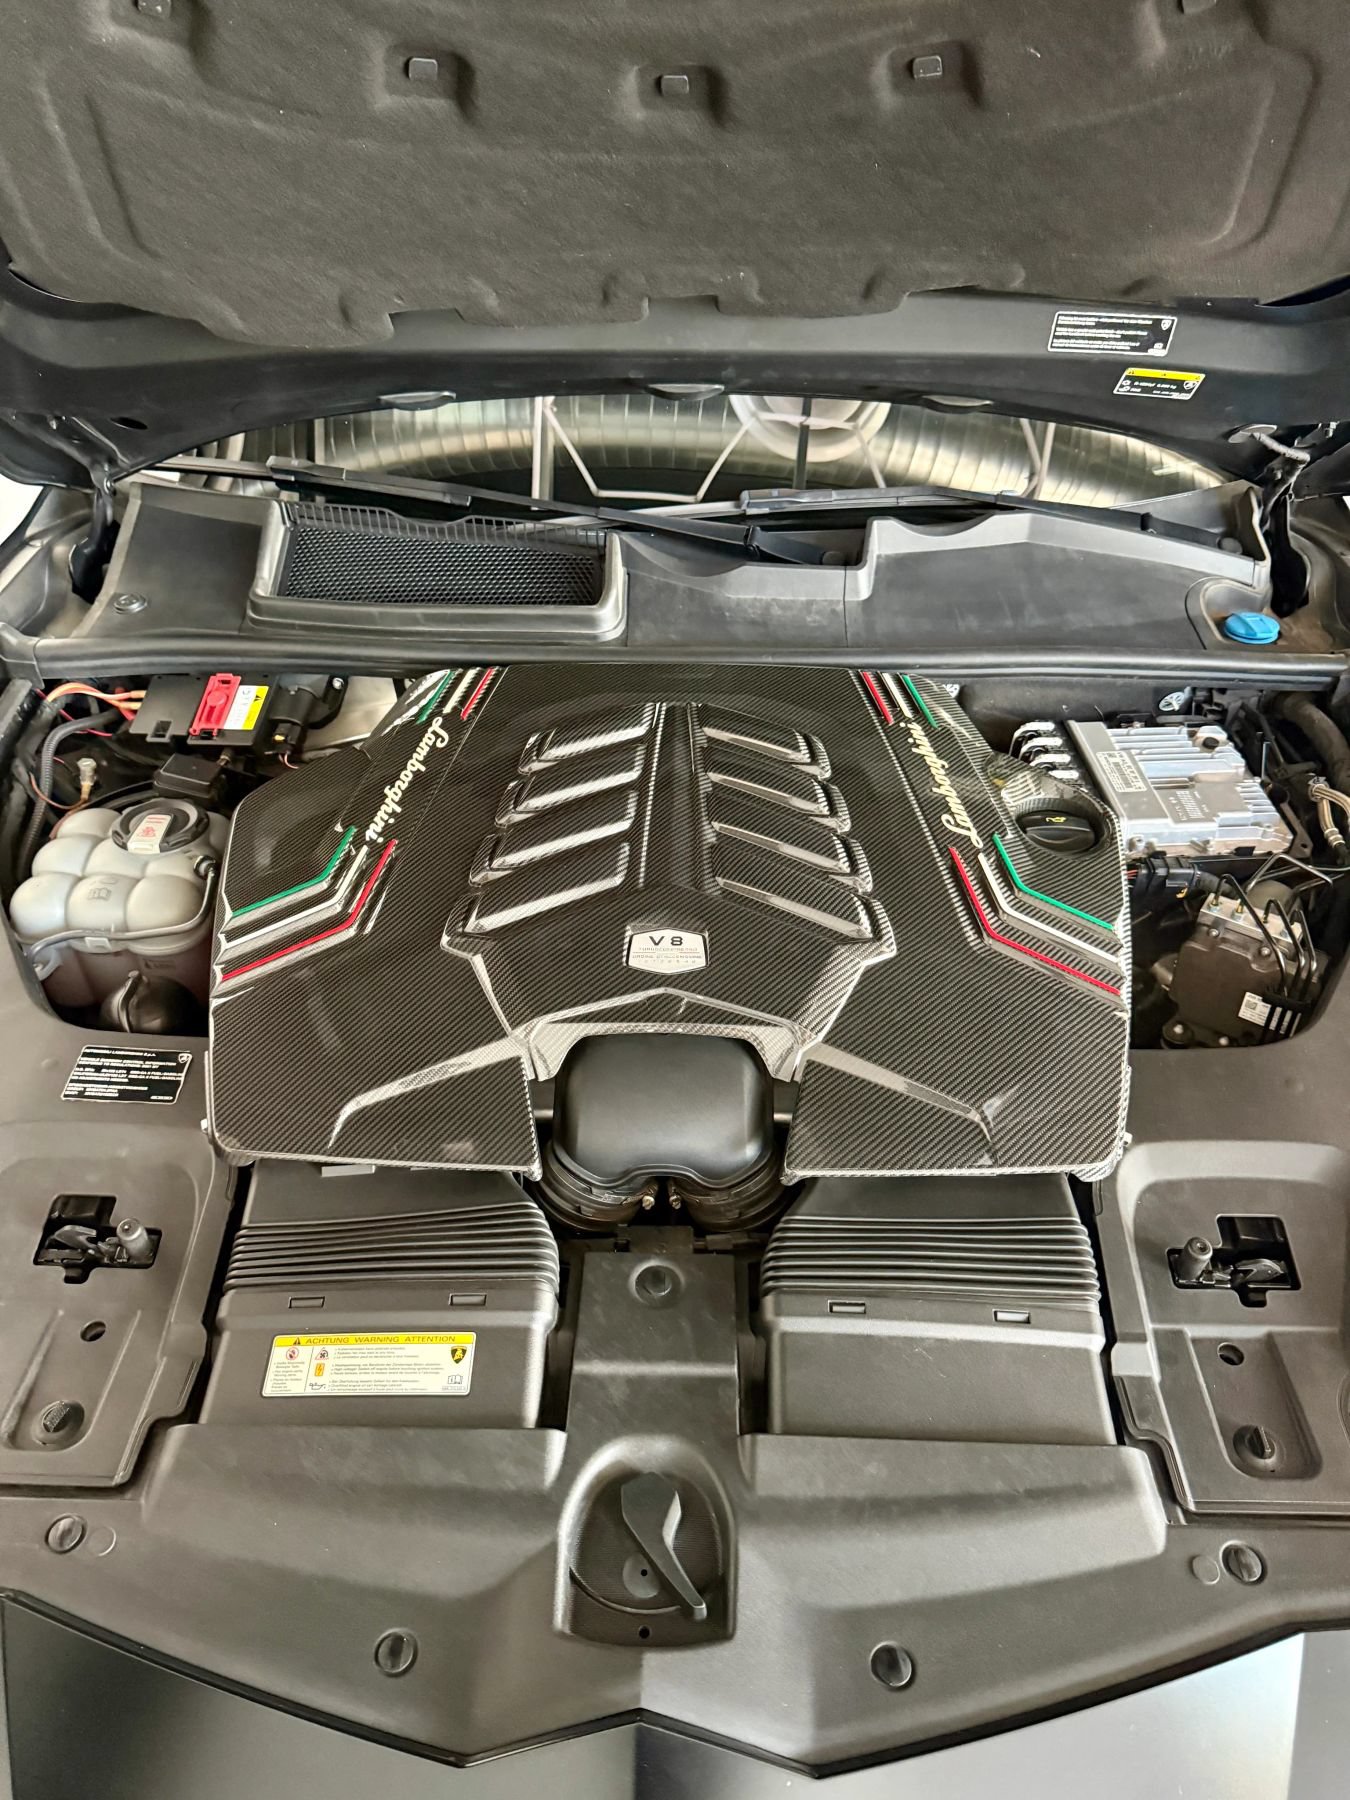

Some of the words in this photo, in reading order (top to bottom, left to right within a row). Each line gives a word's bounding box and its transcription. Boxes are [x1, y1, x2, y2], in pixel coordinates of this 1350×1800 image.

[365, 716, 450, 843] Lamborghini
[900, 722, 984, 849] Lamborghini
[305, 1336, 350, 1345] ACHTUNG
[354, 1335, 400, 1343] WARNING
